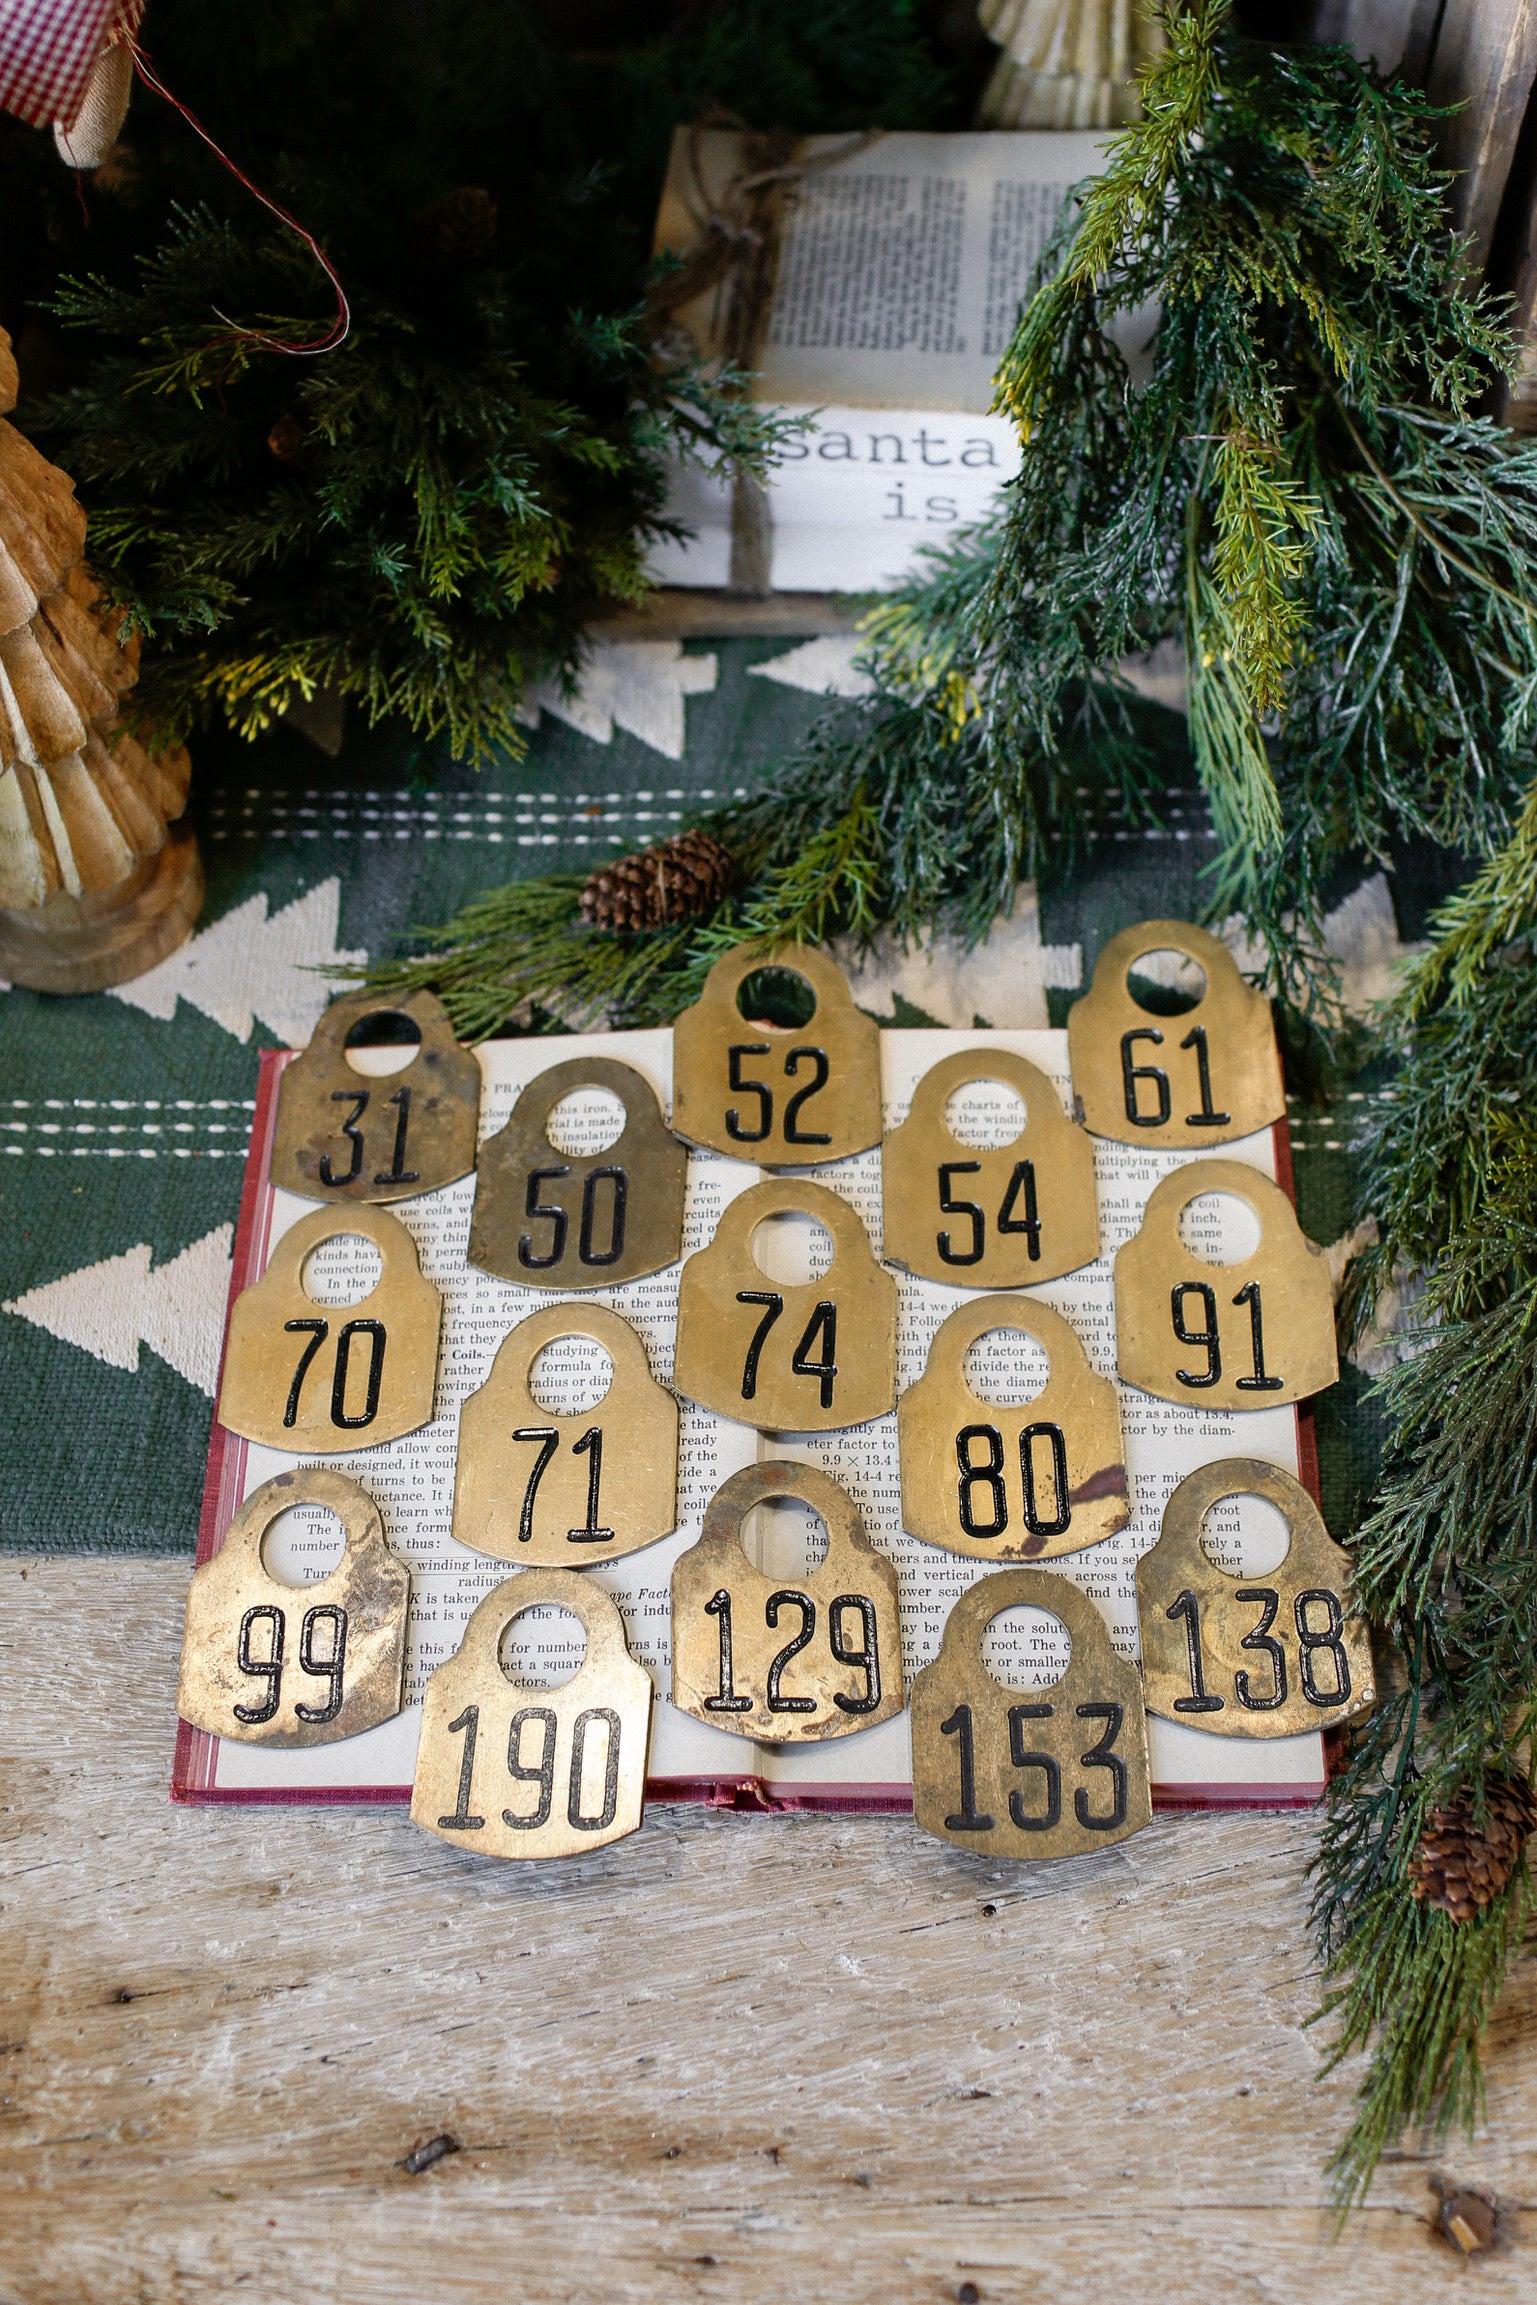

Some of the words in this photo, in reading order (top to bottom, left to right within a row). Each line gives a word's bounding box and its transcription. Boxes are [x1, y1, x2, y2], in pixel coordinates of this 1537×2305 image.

[776, 426, 999, 468] santa
[883, 481, 957, 523] is
[1120, 1025, 1231, 1128] 61
[725, 1044, 832, 1144] 52
[555, 1104, 577, 1114] this
[584, 1104, 609, 1112] iron.
[962, 1101, 1000, 1110] charts
[1007, 1101, 1019, 1109] of
[575, 1117, 583, 1127] is
[589, 1117, 619, 1127] made
[959, 1115, 978, 1123] the
[319, 1085, 420, 1187] 31
[952, 1129, 989, 1138] factor
[811, 1170, 854, 1179] factors
[1127, 1170, 1149, 1179] will
[1100, 1198, 1128, 1208] shall
[1199, 1199, 1219, 1207] coil
[400, 1208, 419, 1216] use
[426, 1206, 452, 1215] coils
[936, 1160, 1041, 1266] 54
[518, 1165, 628, 1269] 50
[1191, 1214, 1221, 1224] inch,
[446, 1219, 468, 1228] and
[810, 1242, 831, 1251] coil
[315, 1250, 348, 1260] kinds
[314, 1265, 378, 1274] connection
[328, 1279, 340, 1289] In
[347, 1278, 366, 1288] the
[497, 1289, 530, 1297] small
[609, 1285, 629, 1294] are
[471, 1304, 482, 1313] in
[501, 1303, 524, 1312] few
[611, 1300, 624, 1309] In
[632, 1300, 650, 1308] the
[901, 1303, 925, 1311] 14-4
[1063, 1302, 1077, 1312] by
[1083, 1302, 1102, 1311] the
[451, 1318, 513, 1330] frequency
[470, 1334, 496, 1345] they
[998, 1331, 1026, 1341] then
[1171, 1281, 1283, 1391] 91
[543, 1345, 599, 1358] studying
[736, 1291, 838, 1409] 74
[987, 1347, 1026, 1356] factor
[444, 1365, 483, 1375] rather
[541, 1361, 591, 1372] formula
[970, 1362, 1010, 1371] divide
[1015, 1362, 1033, 1371] the
[283, 1318, 387, 1429] 70
[529, 1377, 568, 1388] radius
[572, 1378, 585, 1386] or
[980, 1377, 999, 1386] the
[573, 1391, 584, 1401] of
[997, 1394, 1032, 1402] curve
[1164, 1409, 1200, 1418] about
[691, 1420, 717, 1429] that
[807, 1439, 832, 1449] eter
[838, 1439, 877, 1449] factor
[883, 1440, 895, 1449] to
[1153, 1426, 1167, 1436] by
[1174, 1425, 1193, 1435] the
[1200, 1426, 1235, 1435] diam-
[397, 1444, 430, 1453] allow
[330, 1462, 343, 1470] or
[348, 1461, 405, 1471] designed,
[411, 1460, 420, 1469] it
[697, 1451, 717, 1461] the
[822, 1455, 841, 1465] 9.9
[865, 1455, 891, 1465] 13.4
[372, 1476, 404, 1485] turns
[413, 1477, 424, 1485] to
[432, 1476, 445, 1484] be
[855, 1471, 882, 1480] 14-4
[1135, 1475, 1156, 1485] per
[955, 1422, 1070, 1538] 80
[511, 1426, 616, 1543] 71
[432, 1491, 442, 1500] It
[1136, 1490, 1154, 1499] the
[396, 1507, 428, 1516] learn
[878, 1505, 898, 1513] use
[1141, 1505, 1160, 1514] the
[1214, 1506, 1240, 1514] root
[307, 1525, 331, 1534] The
[806, 1520, 820, 1529] of
[886, 1520, 899, 1530] of
[1217, 1522, 1240, 1531] and
[291, 1541, 339, 1551] number
[896, 1538, 914, 1546] we
[418, 1560, 469, 1571] winding
[924, 1554, 947, 1564] and
[1079, 1555, 1091, 1564] If
[1095, 1556, 1118, 1567] you
[924, 1571, 974, 1580] vertical
[1076, 1573, 1116, 1581] across
[1086, 1588, 1110, 1598] find
[427, 1594, 437, 1603] is
[444, 1594, 479, 1603] taken
[411, 1610, 437, 1620] that
[444, 1610, 454, 1620] is
[532, 1608, 552, 1618] the
[925, 1623, 939, 1633] be
[1004, 1623, 1024, 1633] the
[1113, 1626, 1136, 1635] any
[420, 1644, 444, 1654] this
[511, 1643, 533, 1653] for
[657, 1640, 668, 1649] is
[923, 1641, 930, 1649] a
[991, 1640, 1023, 1650] root.
[1030, 1640, 1057, 1650] The
[1166, 1588, 1352, 1712] 138
[703, 1588, 882, 1714] 129
[233, 1604, 349, 1726] 99
[998, 1658, 1010, 1666] or
[1018, 1657, 1068, 1667] smaller
[437, 1704, 622, 1832] 190
[939, 1702, 1128, 1833] 153
